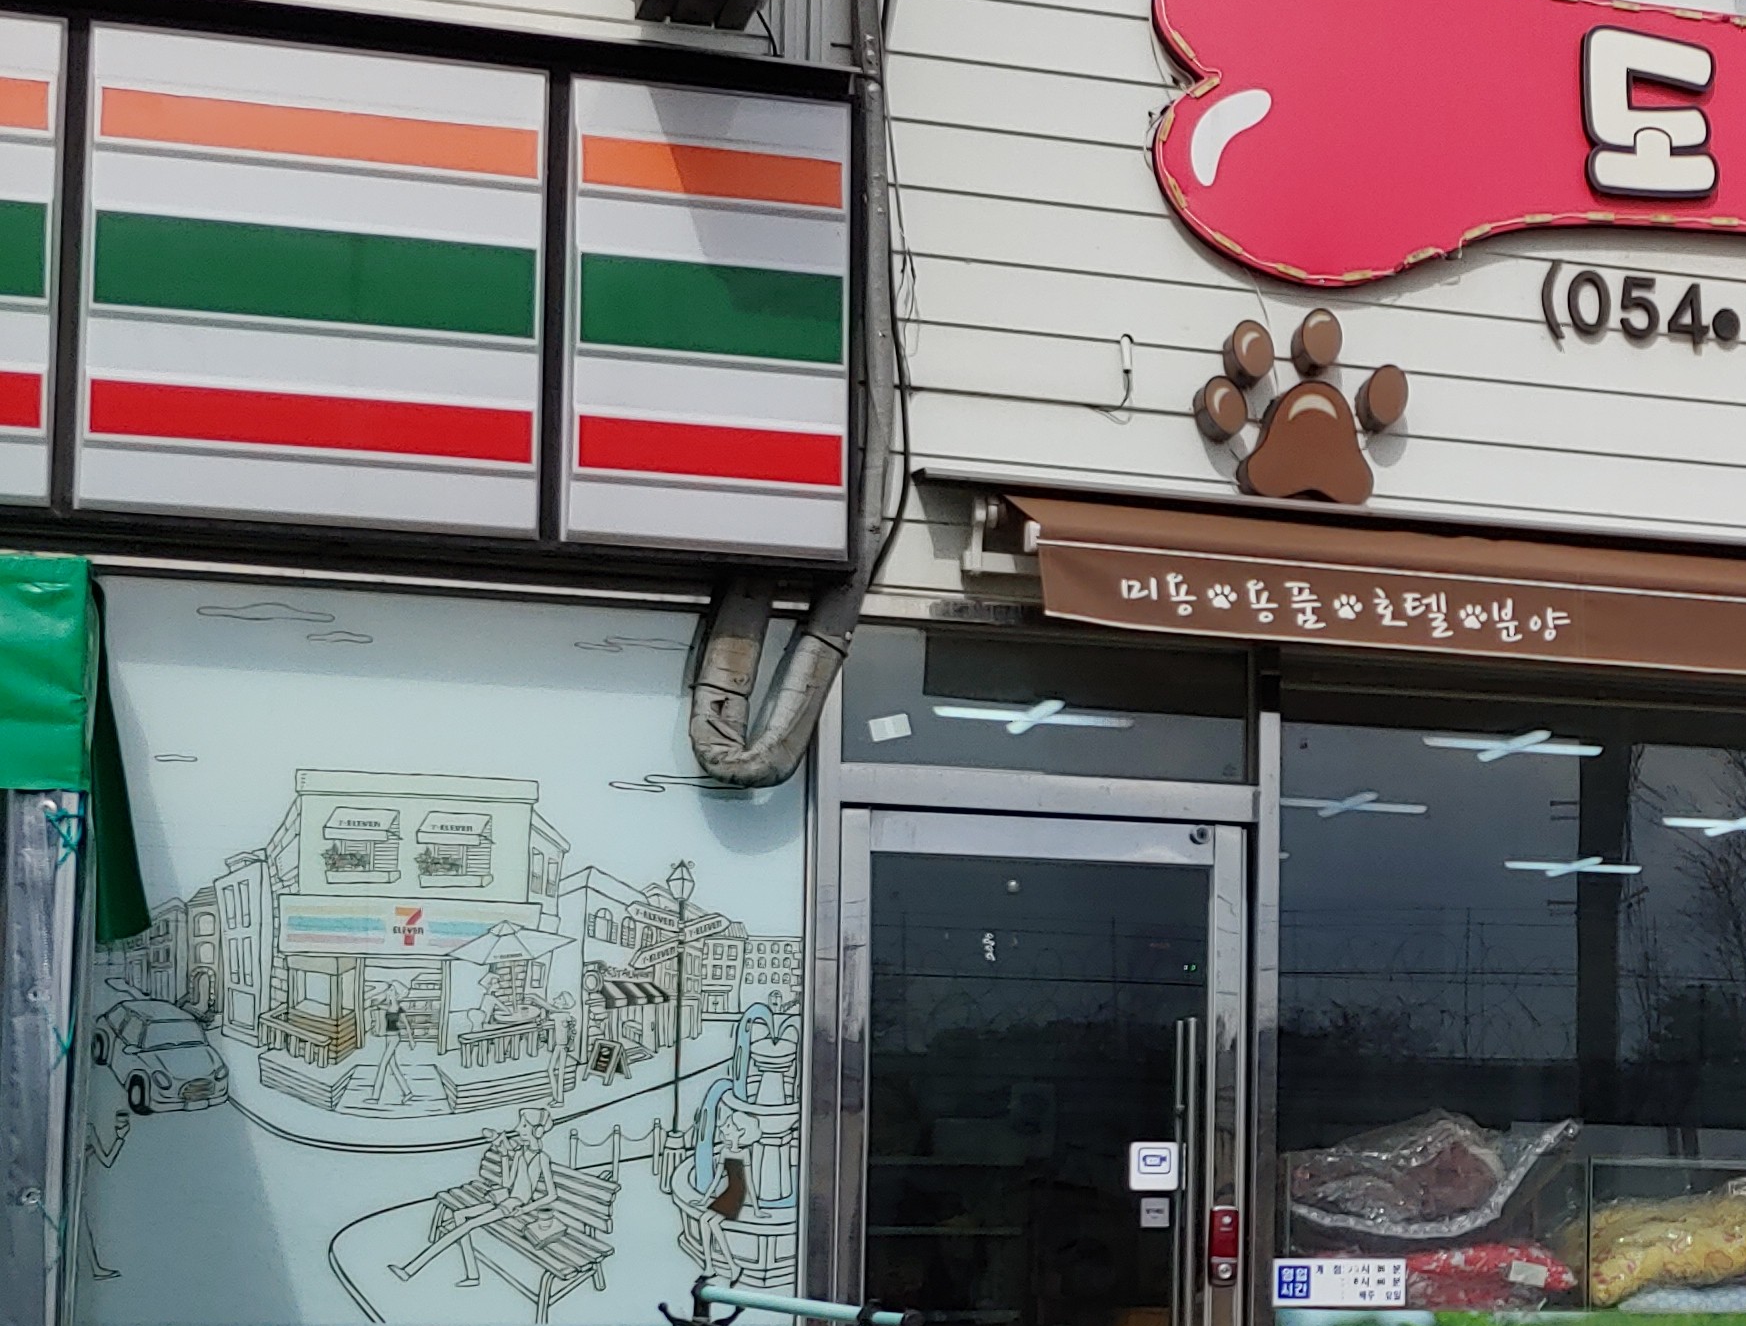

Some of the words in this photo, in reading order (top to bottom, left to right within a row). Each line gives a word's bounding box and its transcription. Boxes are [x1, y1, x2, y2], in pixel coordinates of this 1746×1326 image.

[1120, 572, 1197, 617] 미용
[1246, 579, 1326, 630] 용품
[1373, 587, 1454, 638] 호텔
[1492, 598, 1571, 642] 분양
